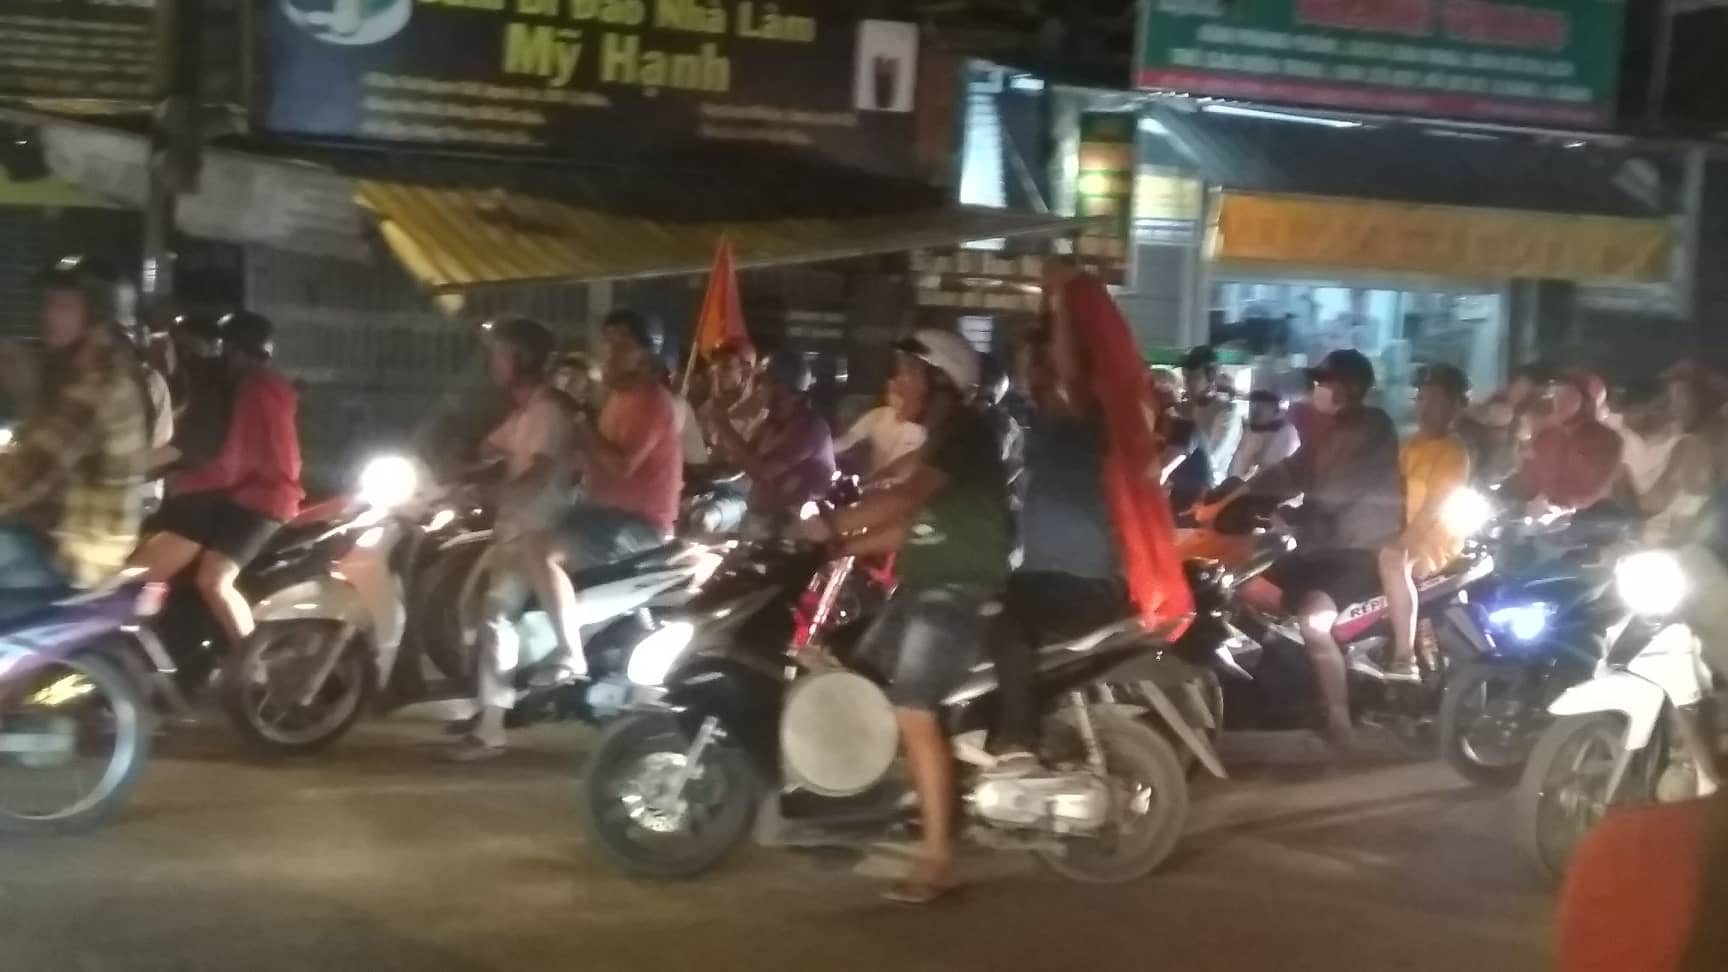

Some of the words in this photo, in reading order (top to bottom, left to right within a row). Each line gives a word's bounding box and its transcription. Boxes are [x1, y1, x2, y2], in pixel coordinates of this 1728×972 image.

[737, 1, 817, 42] Làm
[504, 22, 583, 88] Mỹ
[601, 32, 731, 97] Hạnh
